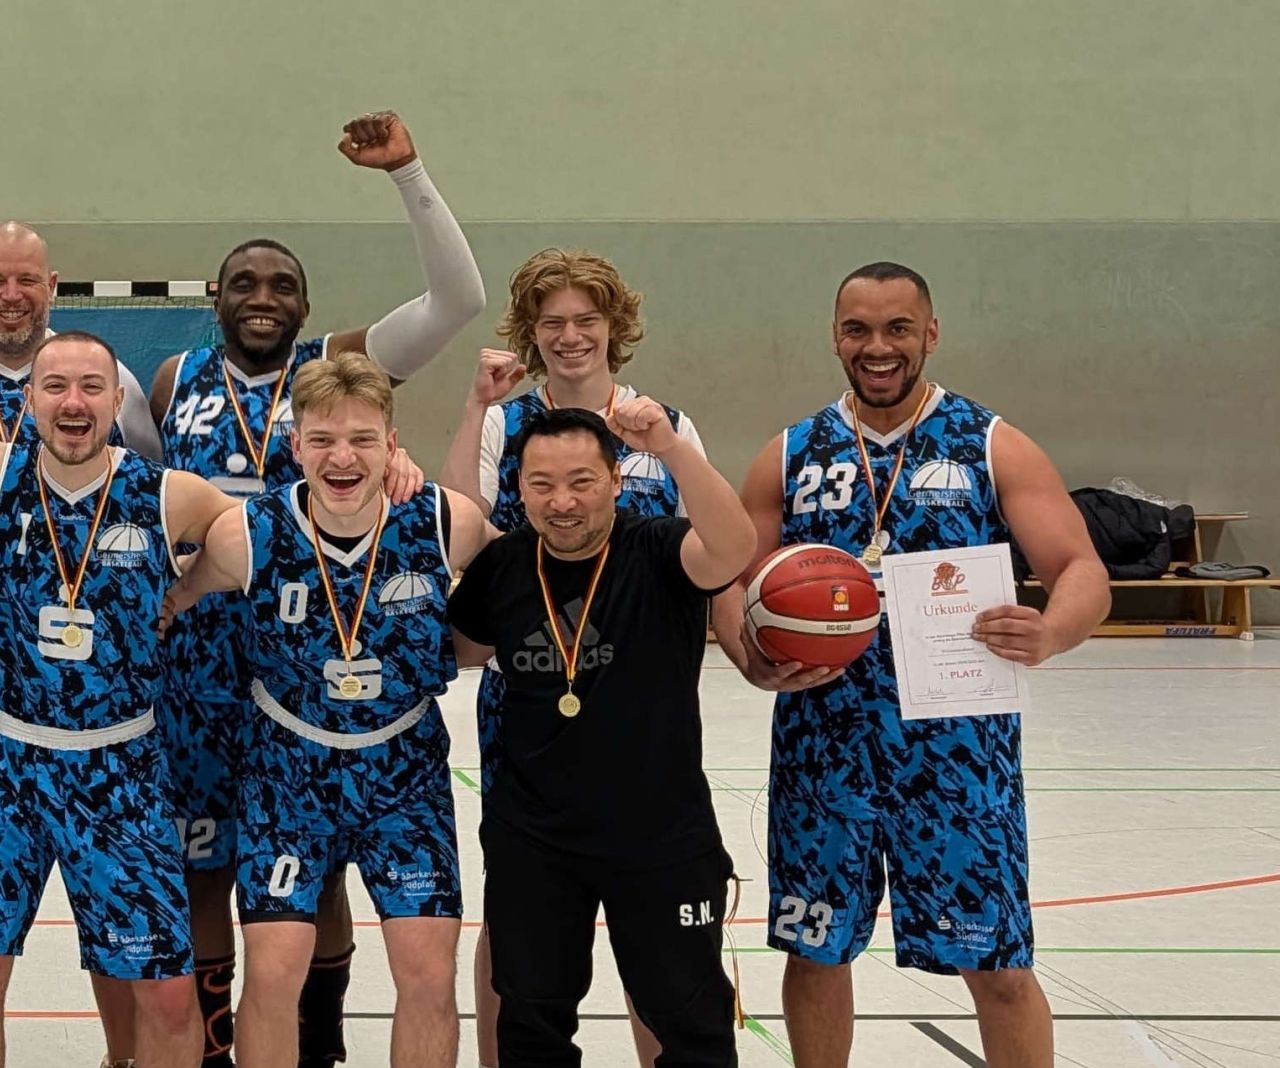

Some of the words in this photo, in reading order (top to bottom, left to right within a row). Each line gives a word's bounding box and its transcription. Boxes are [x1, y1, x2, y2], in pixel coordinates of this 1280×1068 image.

[175, 396, 226, 435] 42
[793, 462, 857, 515] 23
[798, 554, 857, 569] molten
[923, 602, 979, 617] Urkunde
[950, 669, 983, 679] PLATZ
[679, 900, 715, 926] S.N.
[774, 895, 834, 948] 23
